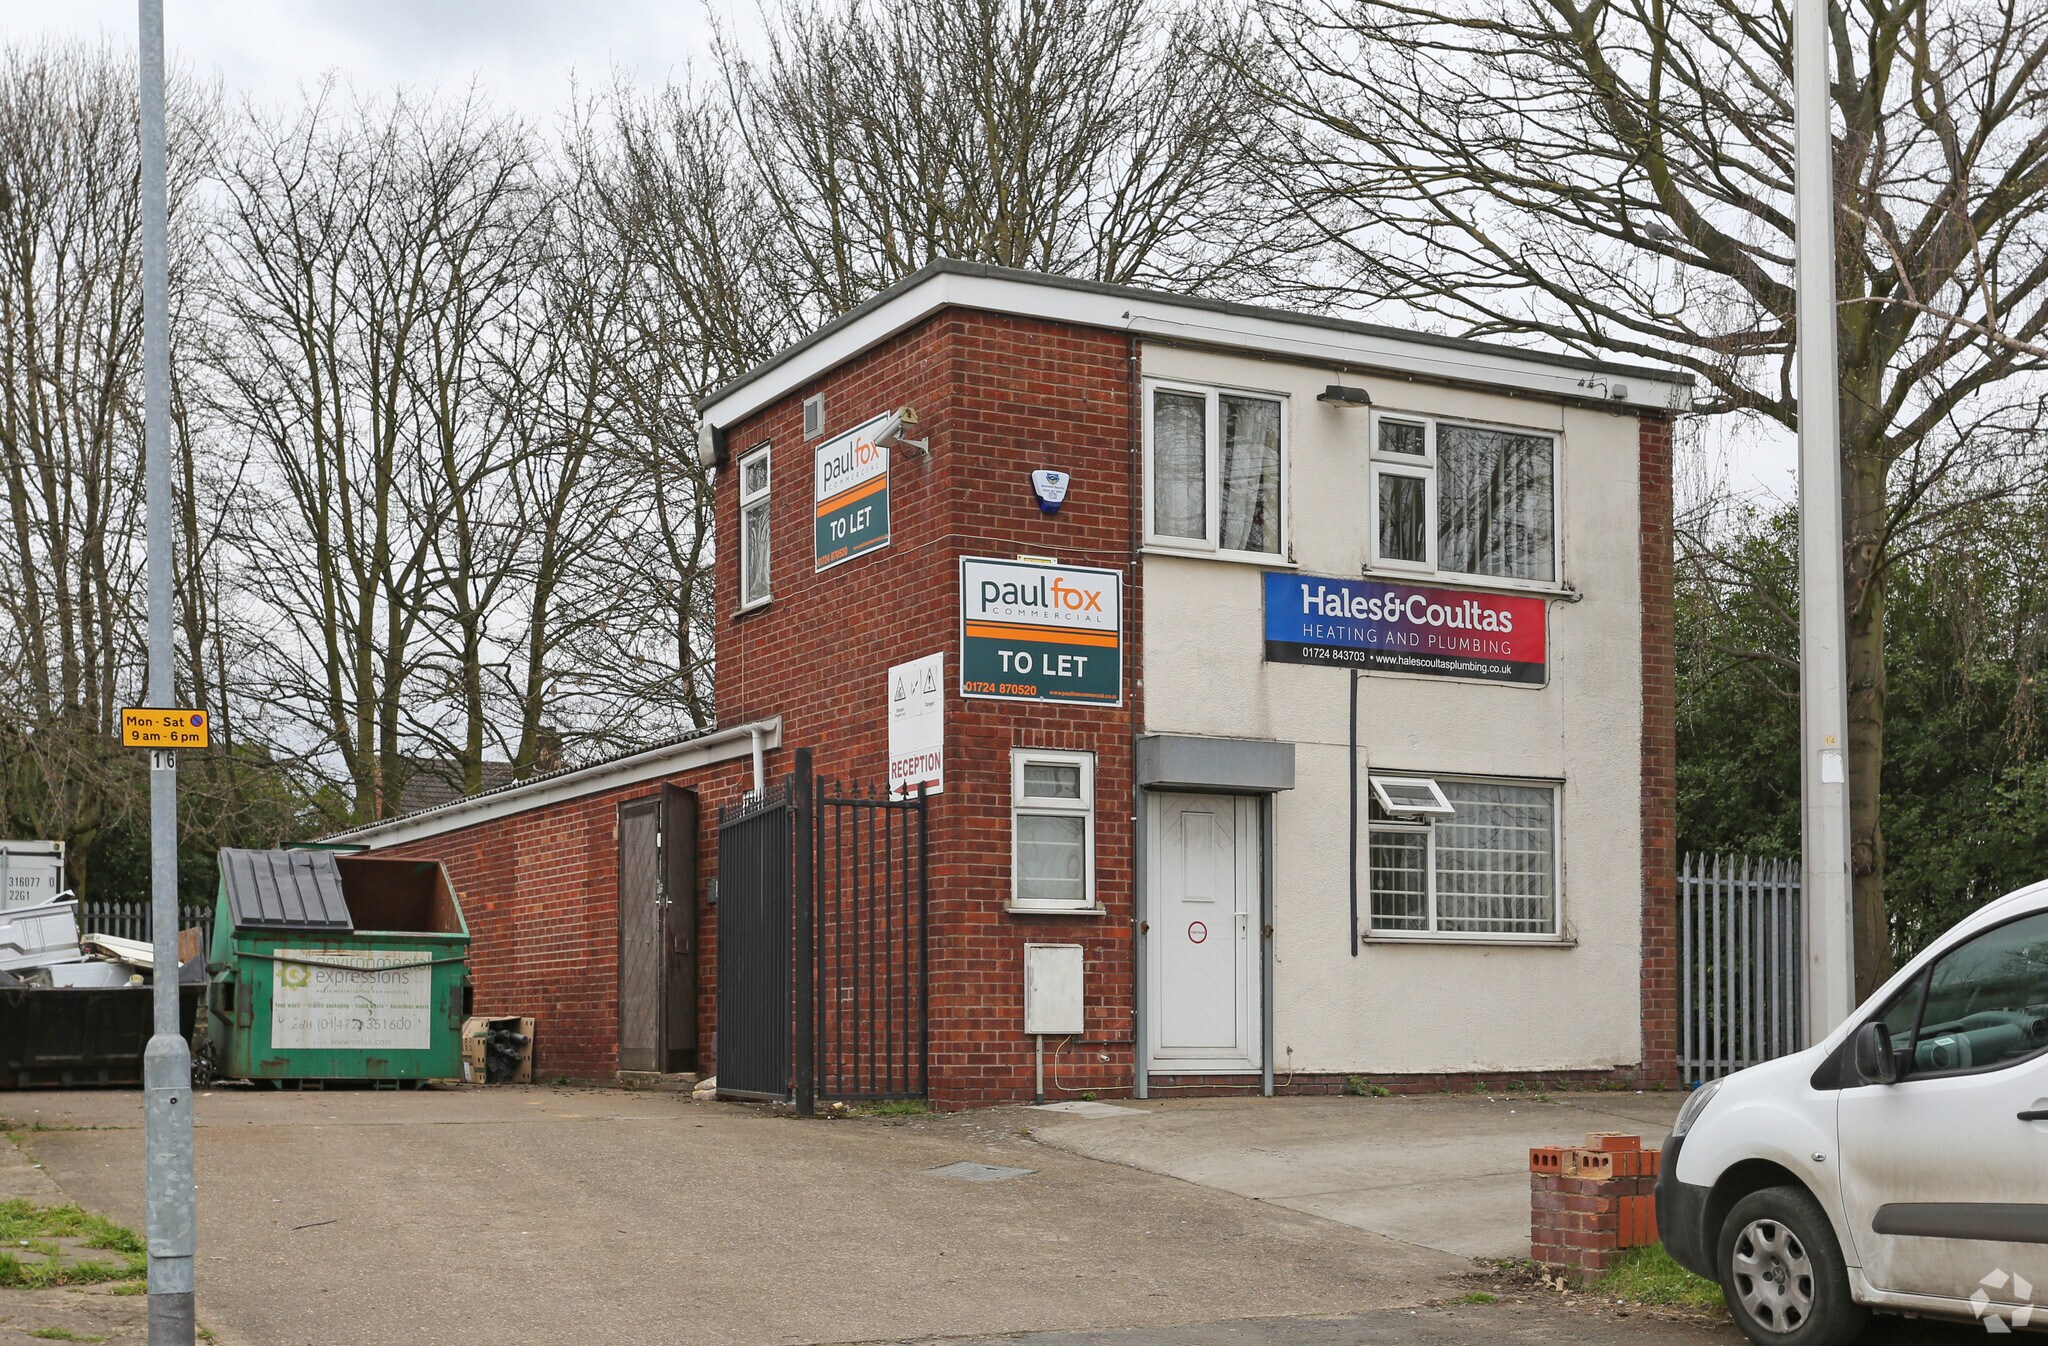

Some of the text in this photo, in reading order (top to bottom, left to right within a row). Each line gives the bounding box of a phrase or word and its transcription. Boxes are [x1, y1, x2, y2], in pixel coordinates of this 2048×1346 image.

[828, 463, 879, 491] COMMERCIAL
[830, 505, 872, 541] TO LET
[993, 607, 1102, 623] COMMERCIAL
[1303, 624, 1511, 655] HEATING AND PLUMBING
[998, 650, 1088, 678] TO LET
[1302, 647, 1511, 675] 01724 843703 www.halescoultasplumbing.co.uk
[965, 681, 996, 693] 01724
[999, 683, 1036, 695] 870520
[126, 716, 153, 726] Mon
[163, 717, 184, 727] Sat
[132, 730, 139, 741] 9
[142, 733, 160, 741] am
[170, 731, 178, 741] 6
[181, 733, 199, 743] pm
[891, 751, 941, 780] RECEPTION
[9, 876, 55, 887] 316077 0
[316, 971, 410, 986] expressions
[366, 1018, 412, 1030] 351600
